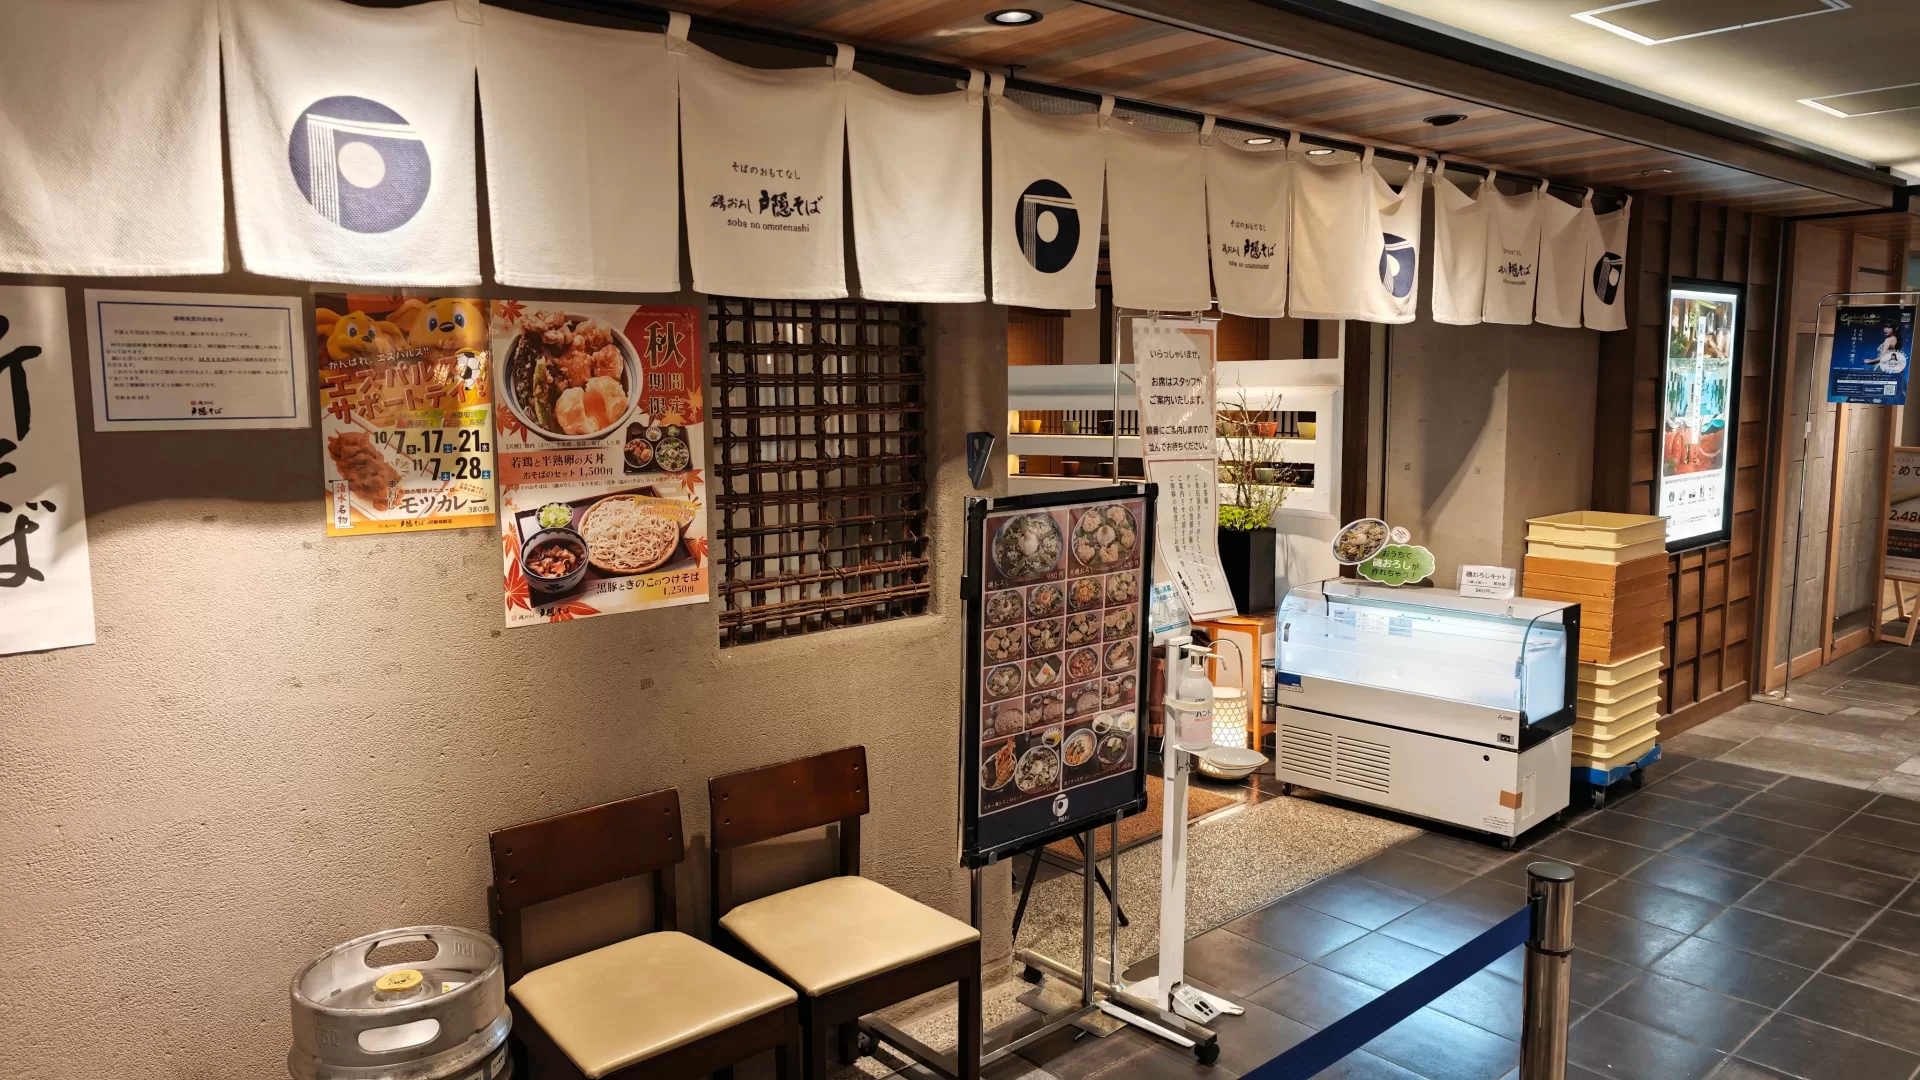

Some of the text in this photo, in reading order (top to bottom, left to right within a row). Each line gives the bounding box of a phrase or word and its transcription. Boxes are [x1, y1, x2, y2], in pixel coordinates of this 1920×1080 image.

[732, 161, 801, 180] そばのおもてなし
[759, 189, 823, 218] 戸隠そば
[727, 218, 810, 233] soba no omotenashi
[644, 320, 686, 368] 秋
[1150, 350, 1201, 360] いらっしゃいませ。
[649, 372, 685, 392] 期間
[1152, 376, 1203, 387] お席はスタッフが
[650, 396, 686, 416] 限定
[1150, 395, 1205, 406] ご案内いたします。
[1146, 425, 1209, 436] 順番にご案内しますので
[1149, 442, 1208, 452] 並んでお待ちください。
[523, 466, 613, 480] おそばのセット 1,500円
[336, 483, 349, 525] 清水名物
[399, 495, 487, 515] モツカレー
[468, 505, 490, 513] 380円
[1382, 550, 1413, 559] おうちで
[596, 572, 700, 594] 黒豚ときのこのつけそば
[663, 584, 694, 597] 1,250円
